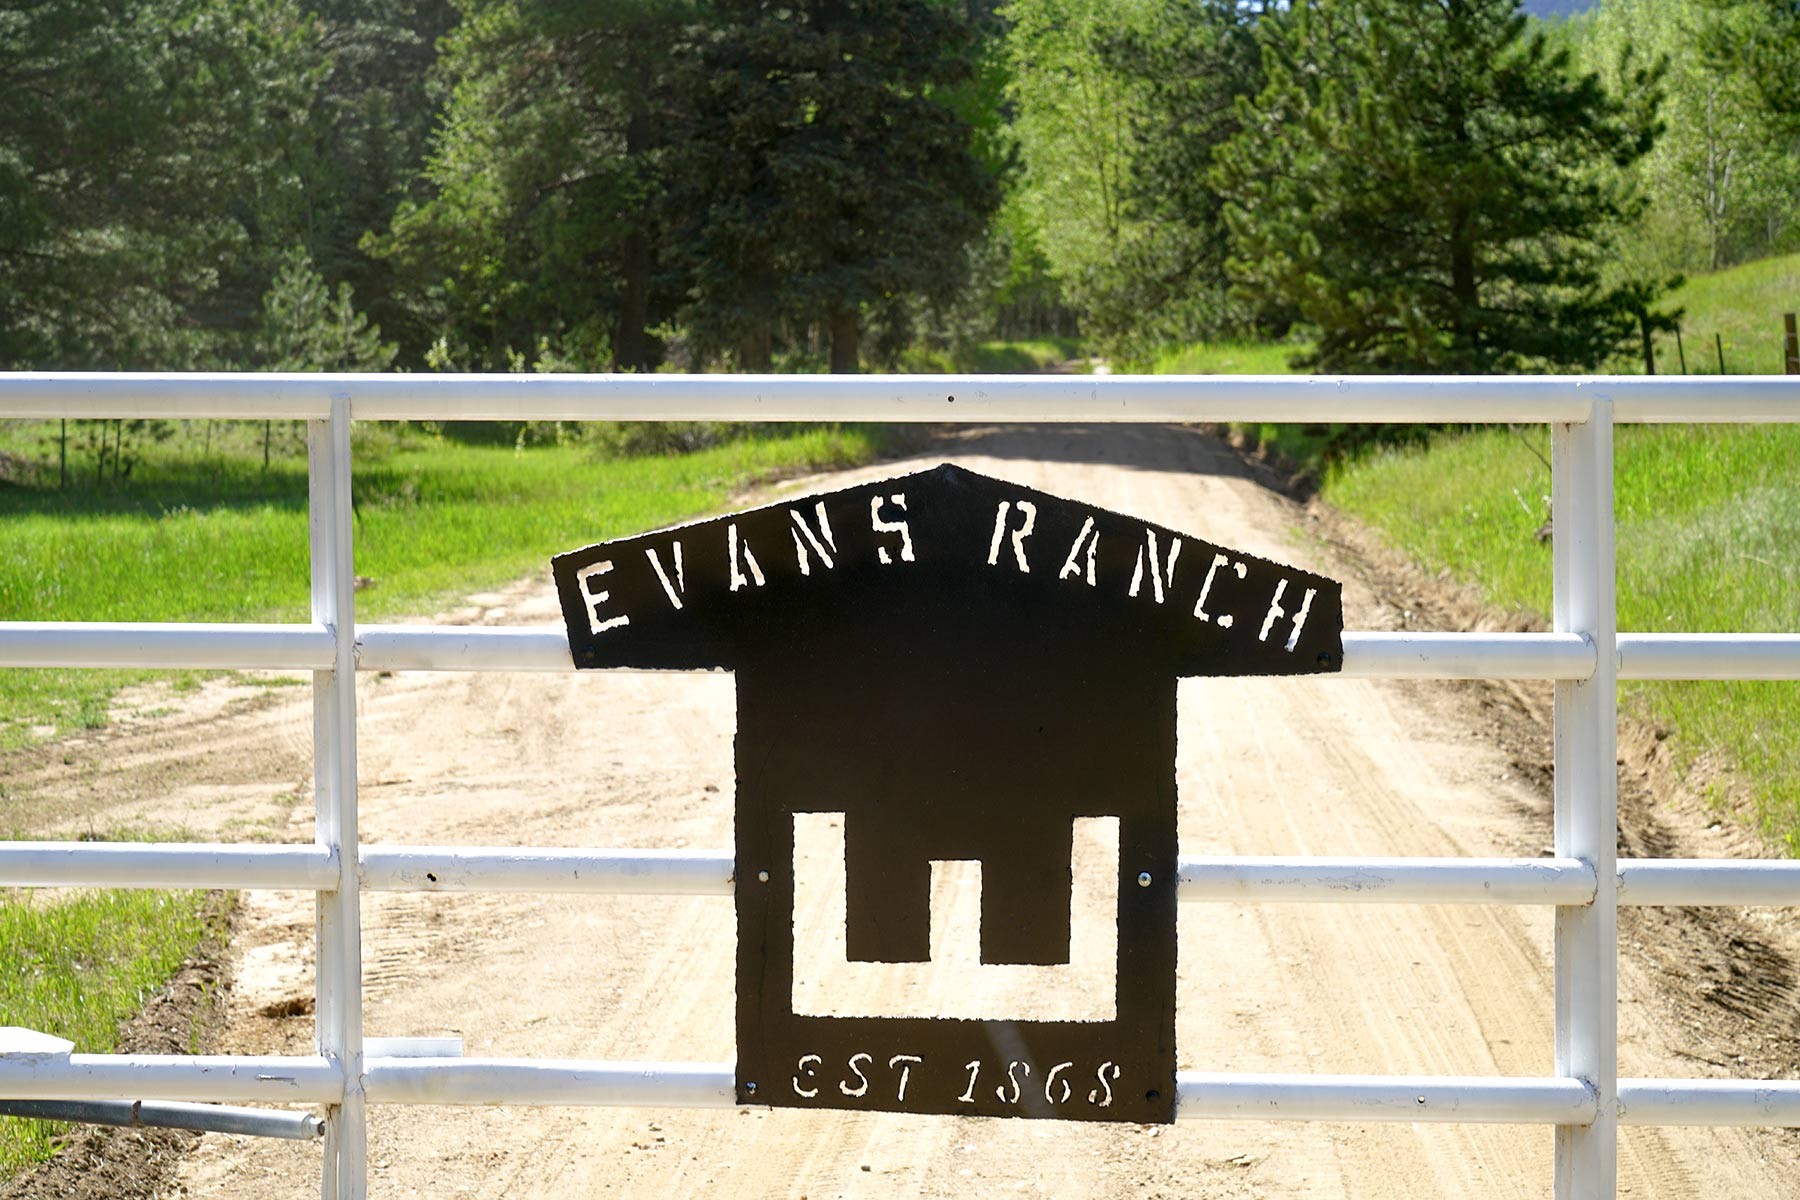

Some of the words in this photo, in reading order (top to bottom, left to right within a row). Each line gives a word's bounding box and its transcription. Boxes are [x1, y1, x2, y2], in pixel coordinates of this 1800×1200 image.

[577, 493, 915, 634] EVANS
[987, 500, 1317, 652] RANCH
[793, 1052, 923, 1098] EST
[957, 1060, 1120, 1107] 1868
